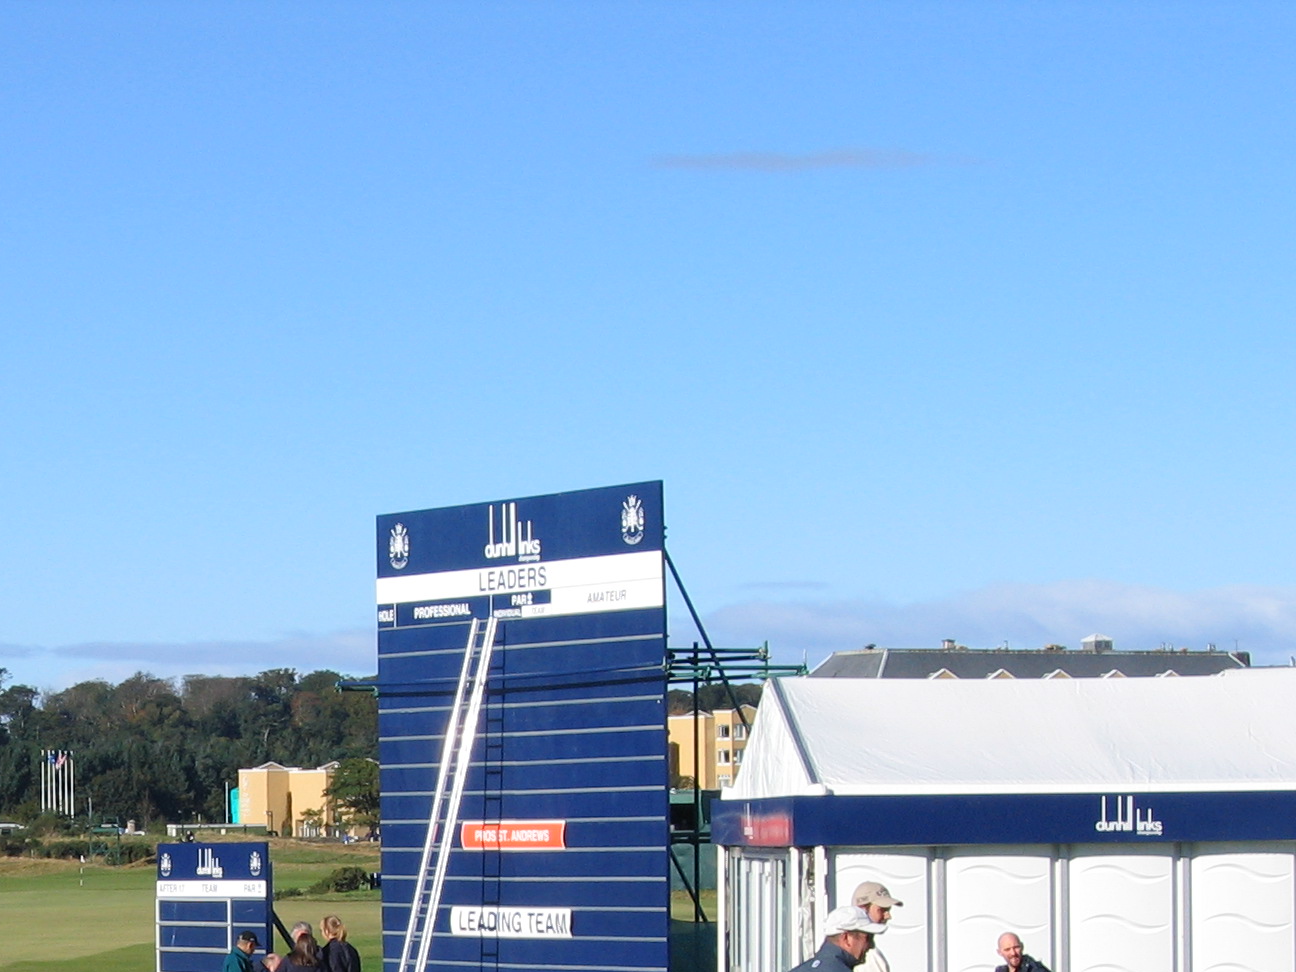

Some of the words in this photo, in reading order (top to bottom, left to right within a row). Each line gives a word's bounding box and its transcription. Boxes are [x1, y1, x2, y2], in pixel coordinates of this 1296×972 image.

[478, 566, 547, 592] LEADERS
[587, 589, 627, 603] AMATEUR
[378, 609, 394, 622] HOLE
[414, 603, 471, 619] PROFESSIONAL
[511, 829, 549, 842] ANDREWS
[459, 911, 521, 934] LEADING
[528, 912, 568, 934] TEAM
